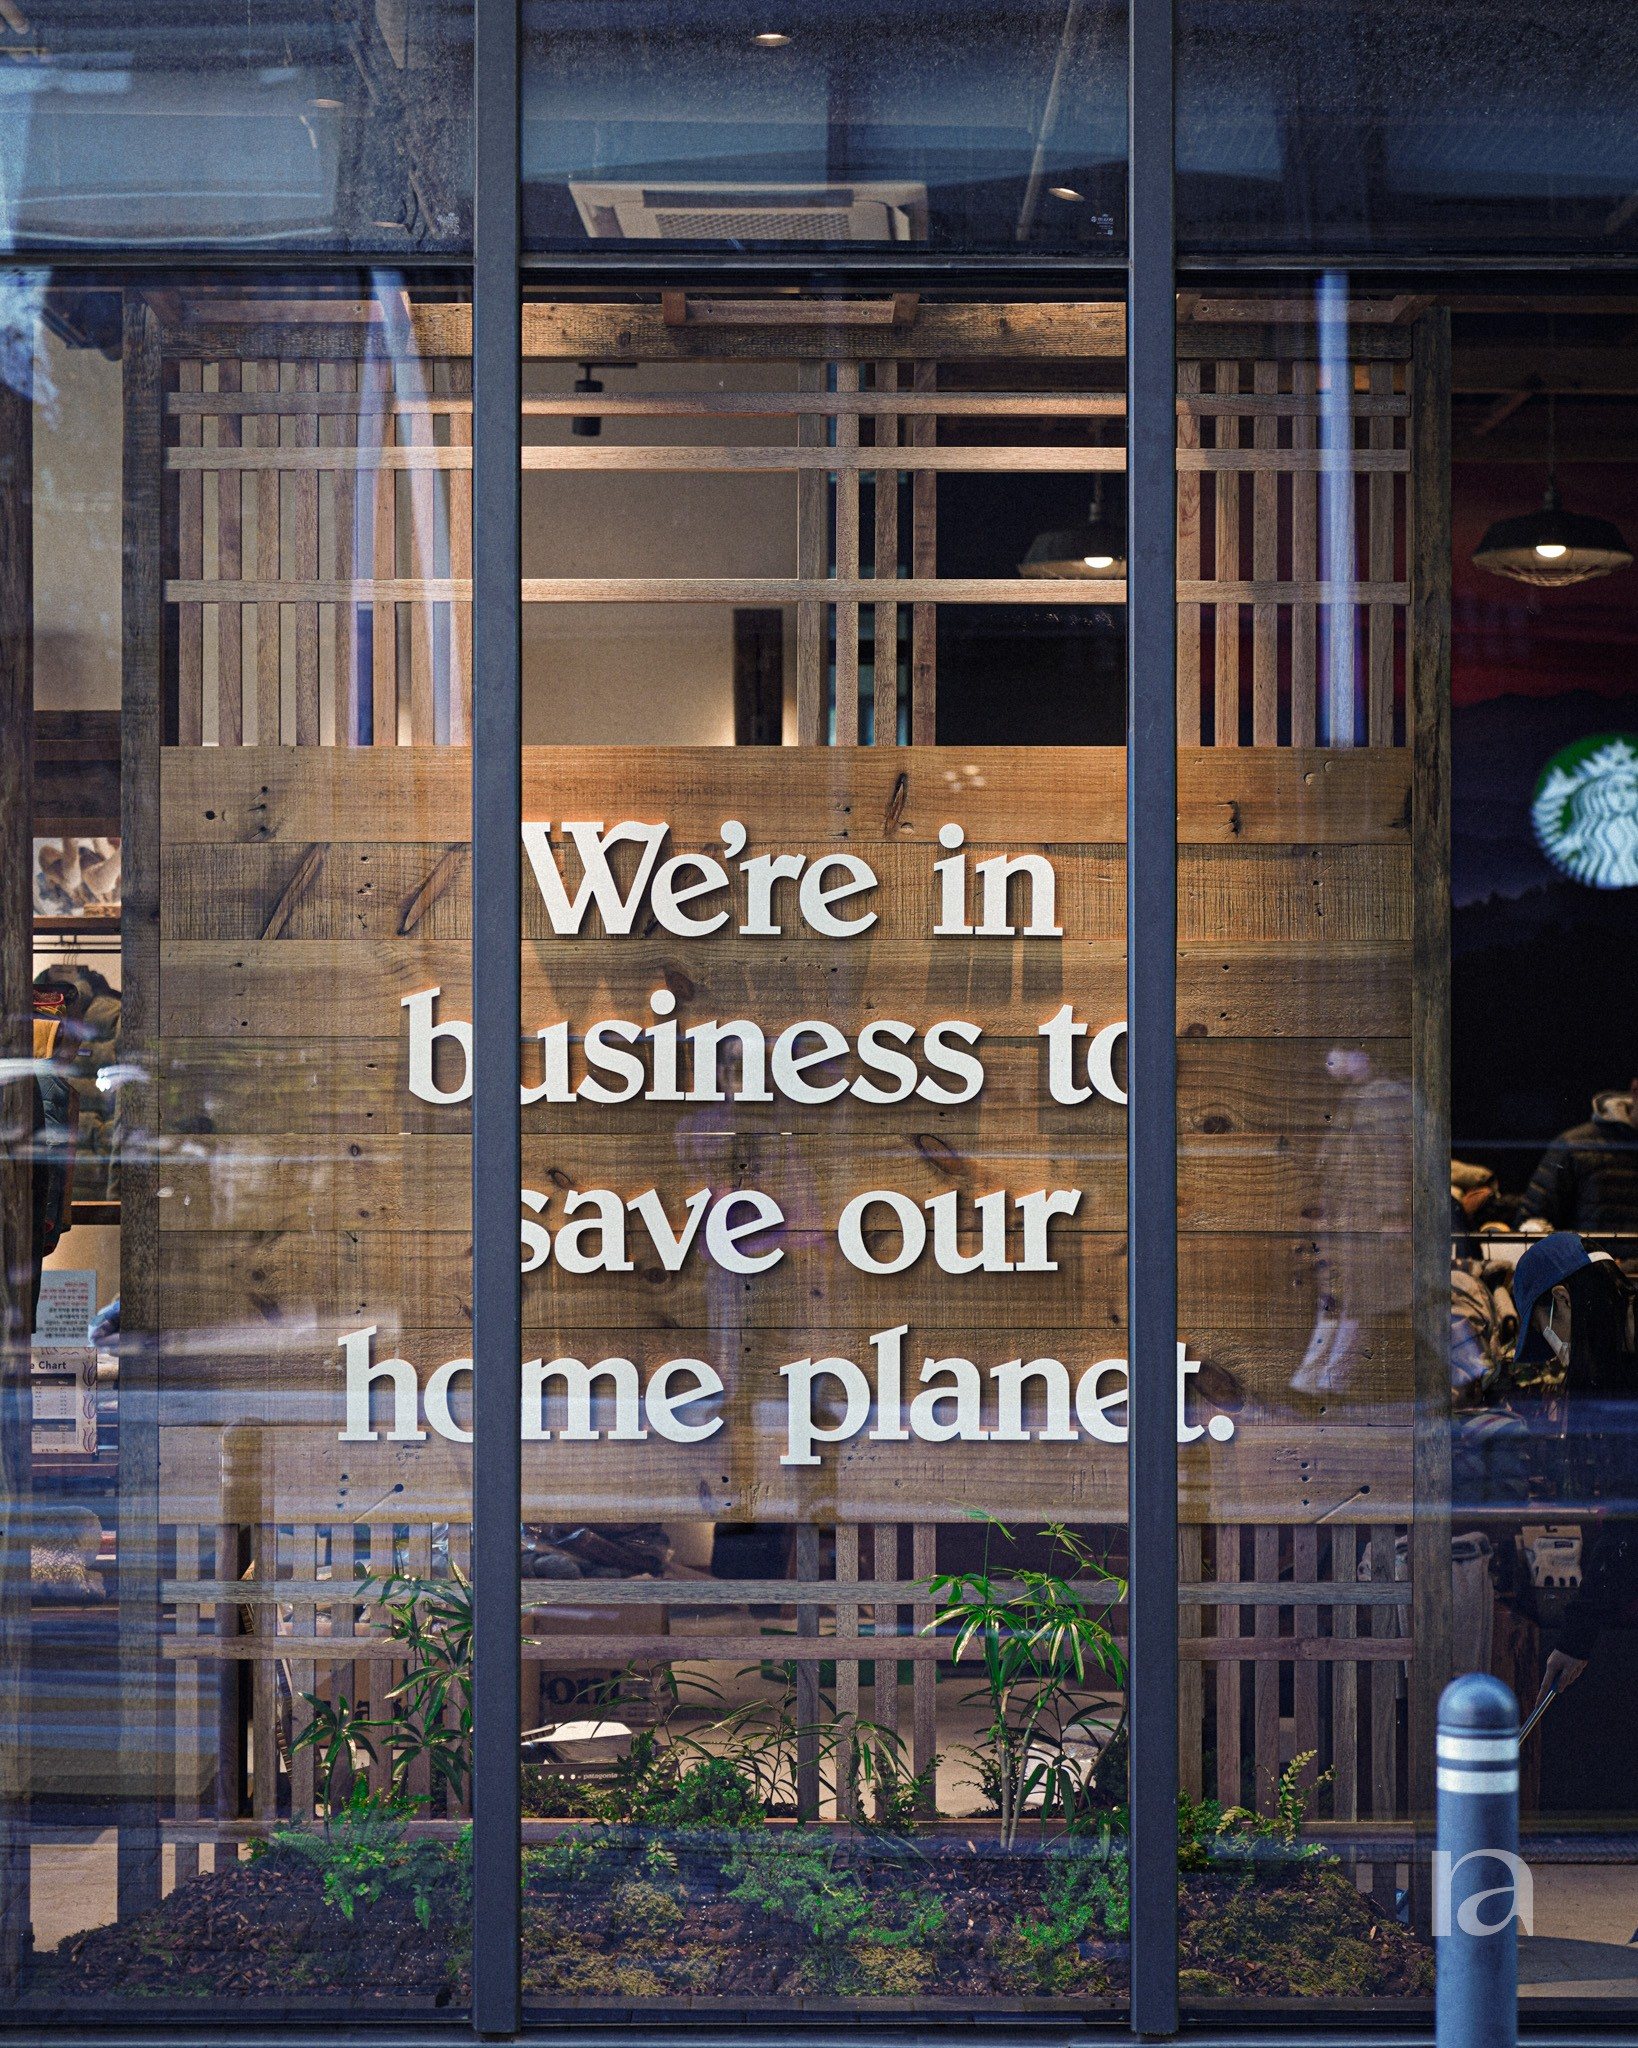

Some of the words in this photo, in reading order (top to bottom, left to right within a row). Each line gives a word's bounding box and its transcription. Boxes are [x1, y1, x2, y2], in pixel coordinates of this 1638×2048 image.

[521, 820, 878, 937] We’re
[932, 822, 1064, 936] in
[401, 986, 984, 1105] business
[837, 1188, 1082, 1275] our
[38, 1361, 67, 1370] Chart
[337, 1325, 725, 1443] home
